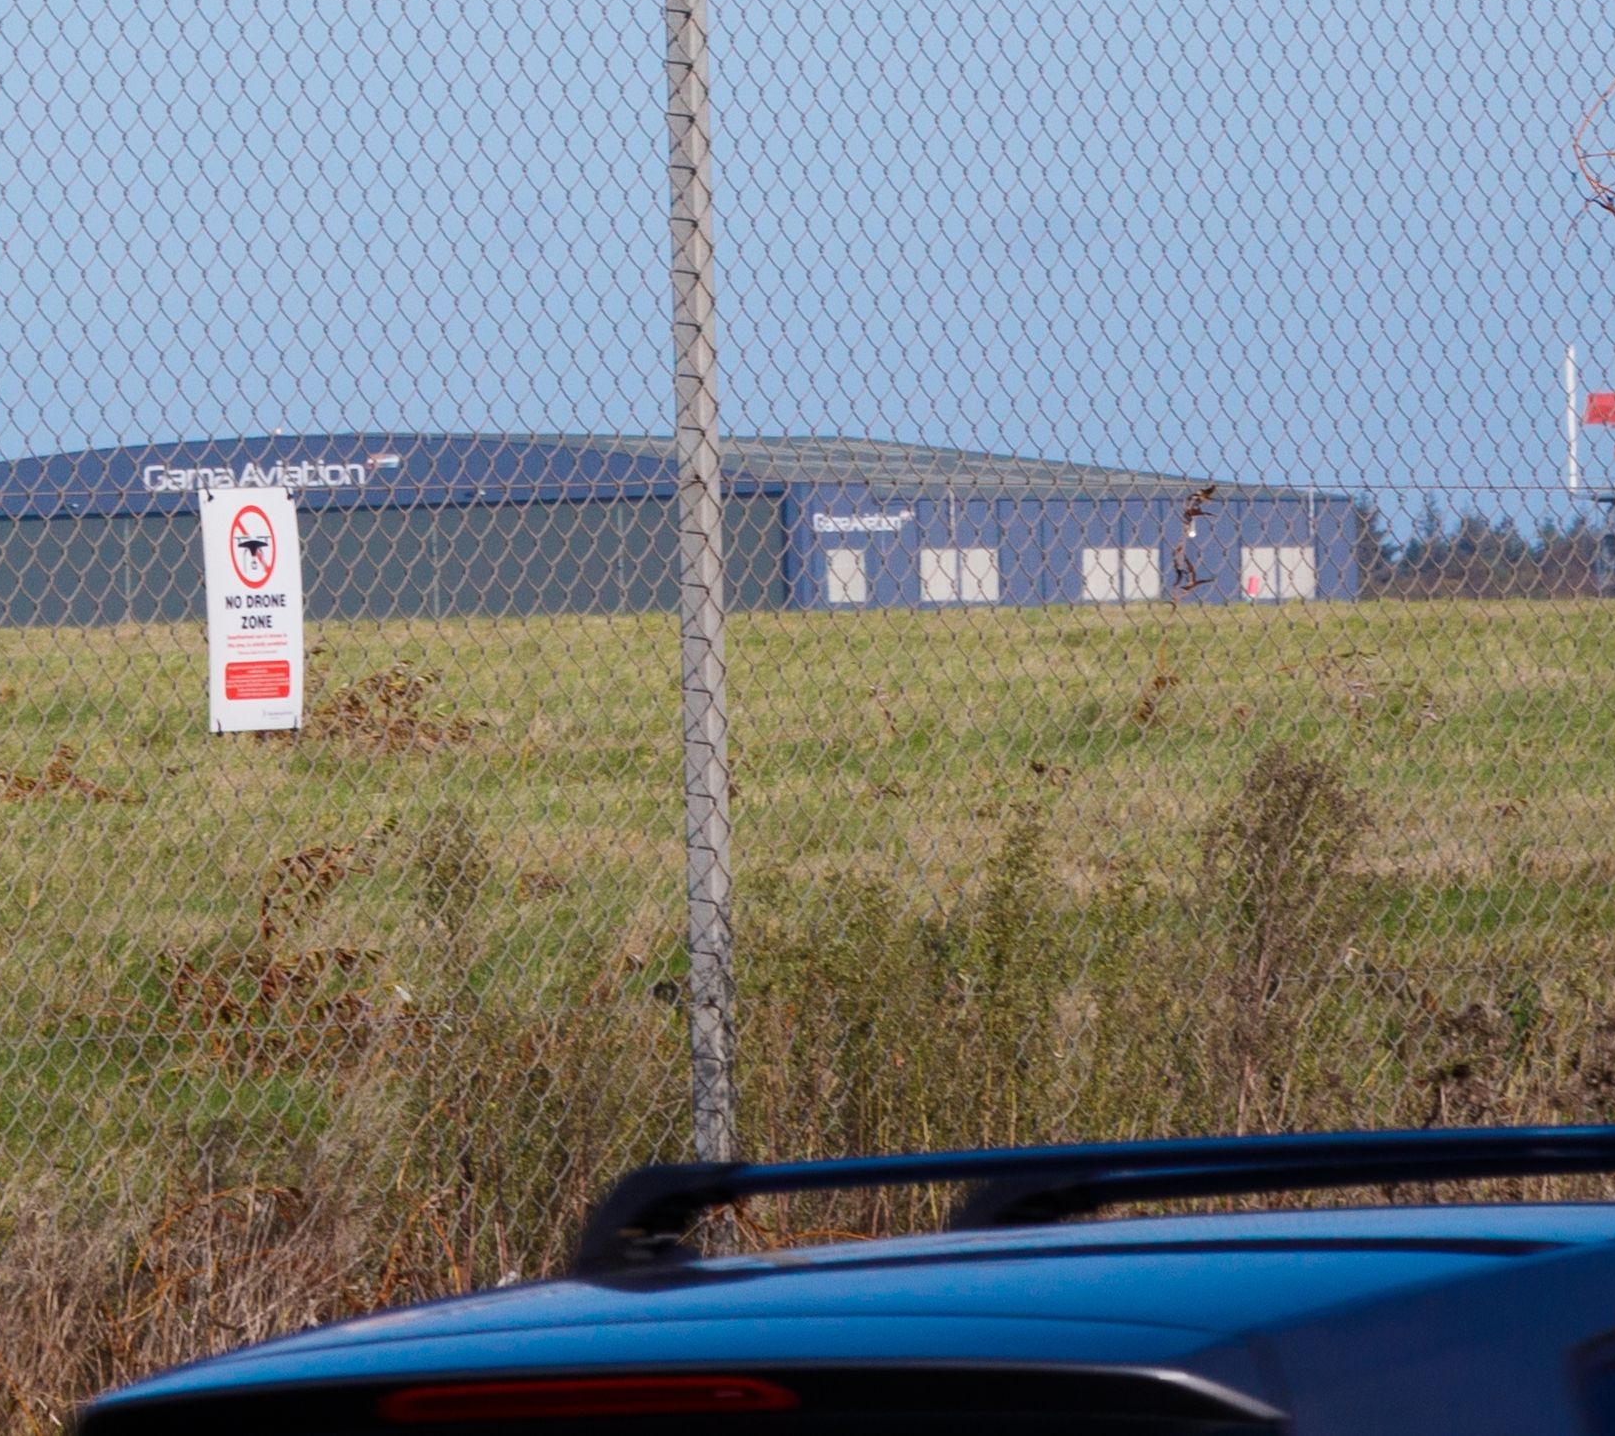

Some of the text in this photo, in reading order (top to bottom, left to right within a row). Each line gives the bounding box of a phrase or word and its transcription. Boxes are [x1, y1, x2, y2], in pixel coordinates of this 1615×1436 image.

[143, 460, 365, 492] Gama Aviation
[225, 594, 286, 609] NO DRONE
[241, 615, 273, 629] ZONE
